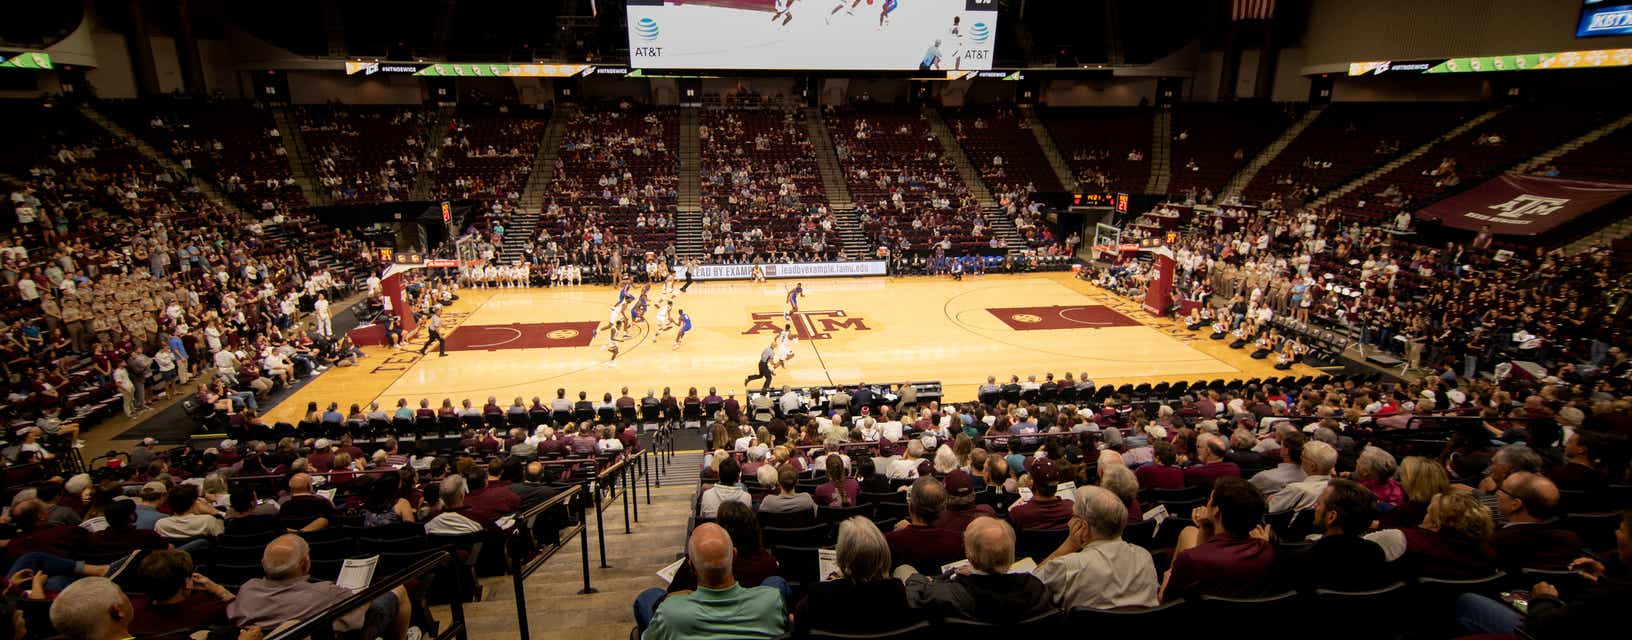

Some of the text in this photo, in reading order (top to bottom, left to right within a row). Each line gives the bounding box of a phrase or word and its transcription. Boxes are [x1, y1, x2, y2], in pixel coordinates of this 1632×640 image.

[635, 47, 662, 57] AT&T
[965, 50, 989, 60] AT&T
[692, 267, 711, 278] EAD
[714, 267, 723, 277] BY
[726, 266, 753, 277] EXAMP
[781, 263, 869, 275] leadbyexample.tamu.edu
